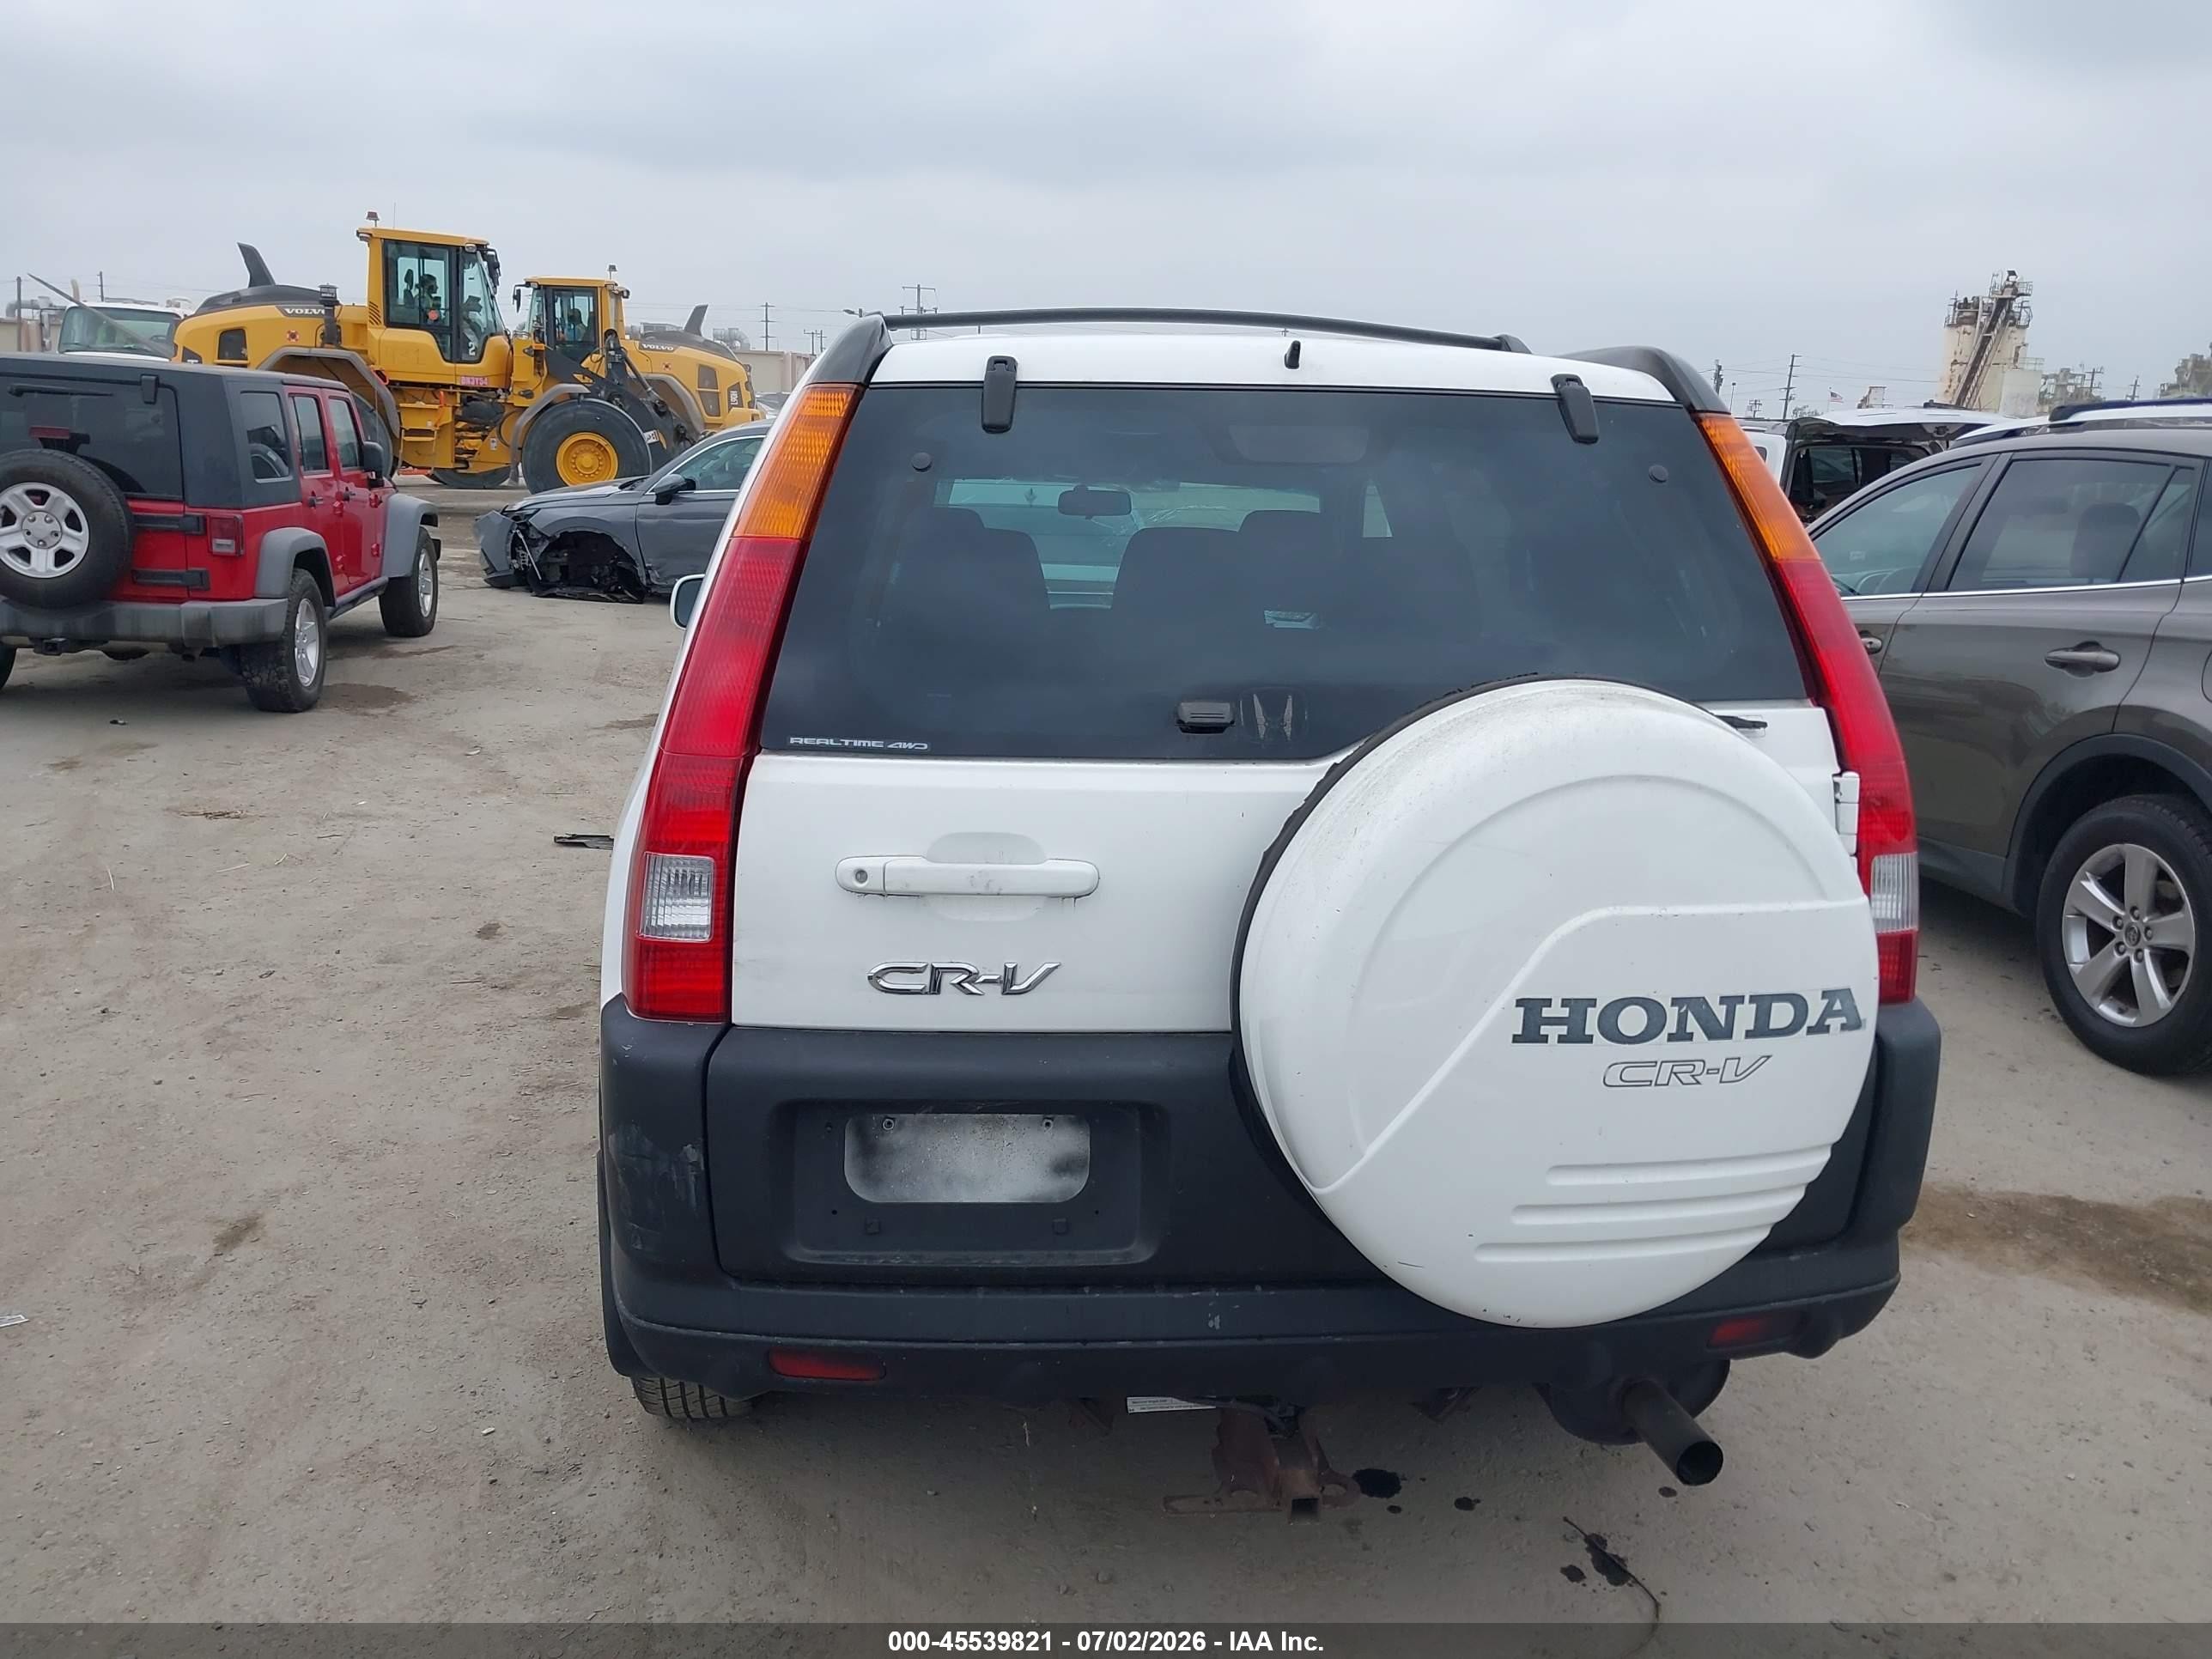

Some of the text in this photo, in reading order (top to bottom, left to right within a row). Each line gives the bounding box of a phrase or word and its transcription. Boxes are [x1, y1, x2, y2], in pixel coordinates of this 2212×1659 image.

[468, 342, 476, 356] 2
[642, 343, 674, 351] VOLVO
[790, 737, 884, 748] REALTIME
[867, 962, 1061, 995] CR-V
[1511, 988, 1865, 1045] HONDA
[1603, 1054, 1773, 1088] CR-V
